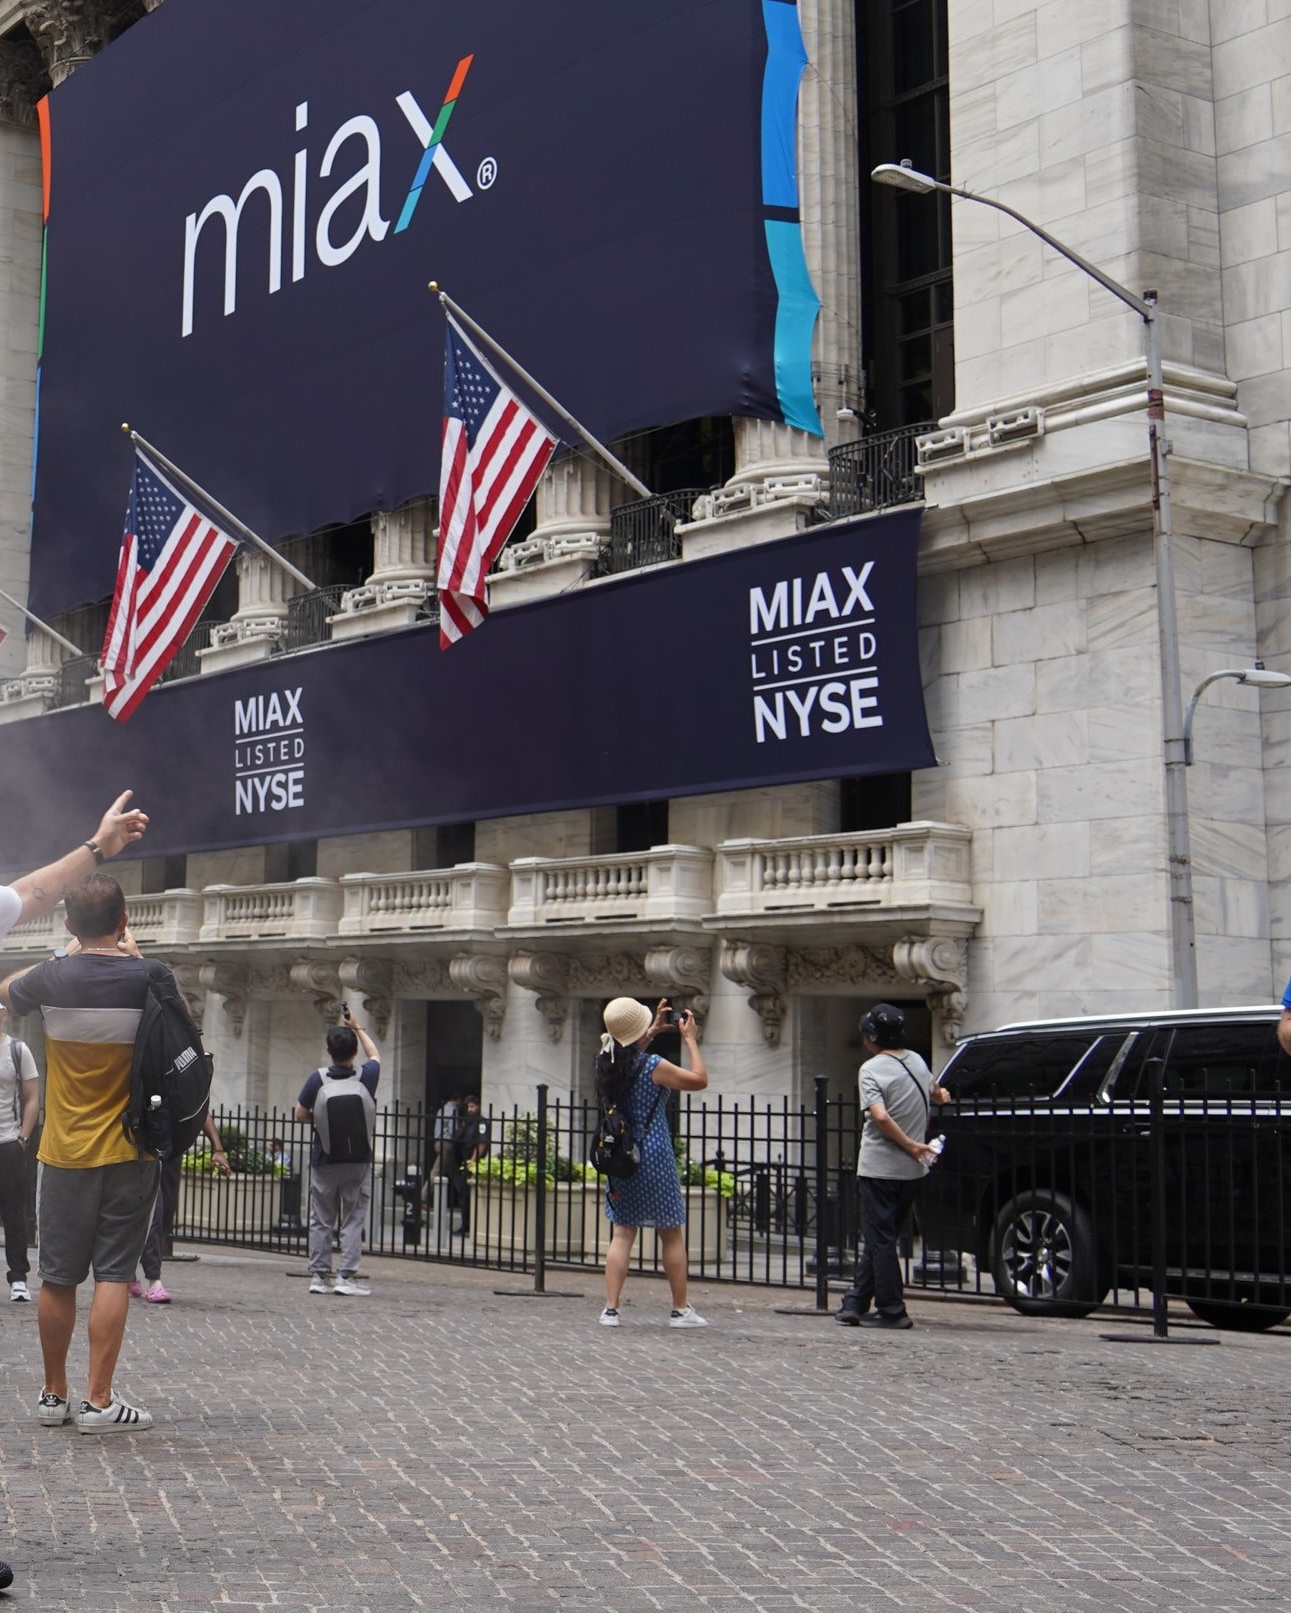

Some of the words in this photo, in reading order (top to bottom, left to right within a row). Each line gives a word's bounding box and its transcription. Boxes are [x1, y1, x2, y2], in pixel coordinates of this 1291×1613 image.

[749, 560, 875, 635] MIAX
[751, 632, 877, 679] LISTED
[234, 687, 304, 735] MIAX
[753, 677, 884, 744] NYSE
[235, 738, 305, 768] LISTED
[235, 770, 305, 816] NYSE
